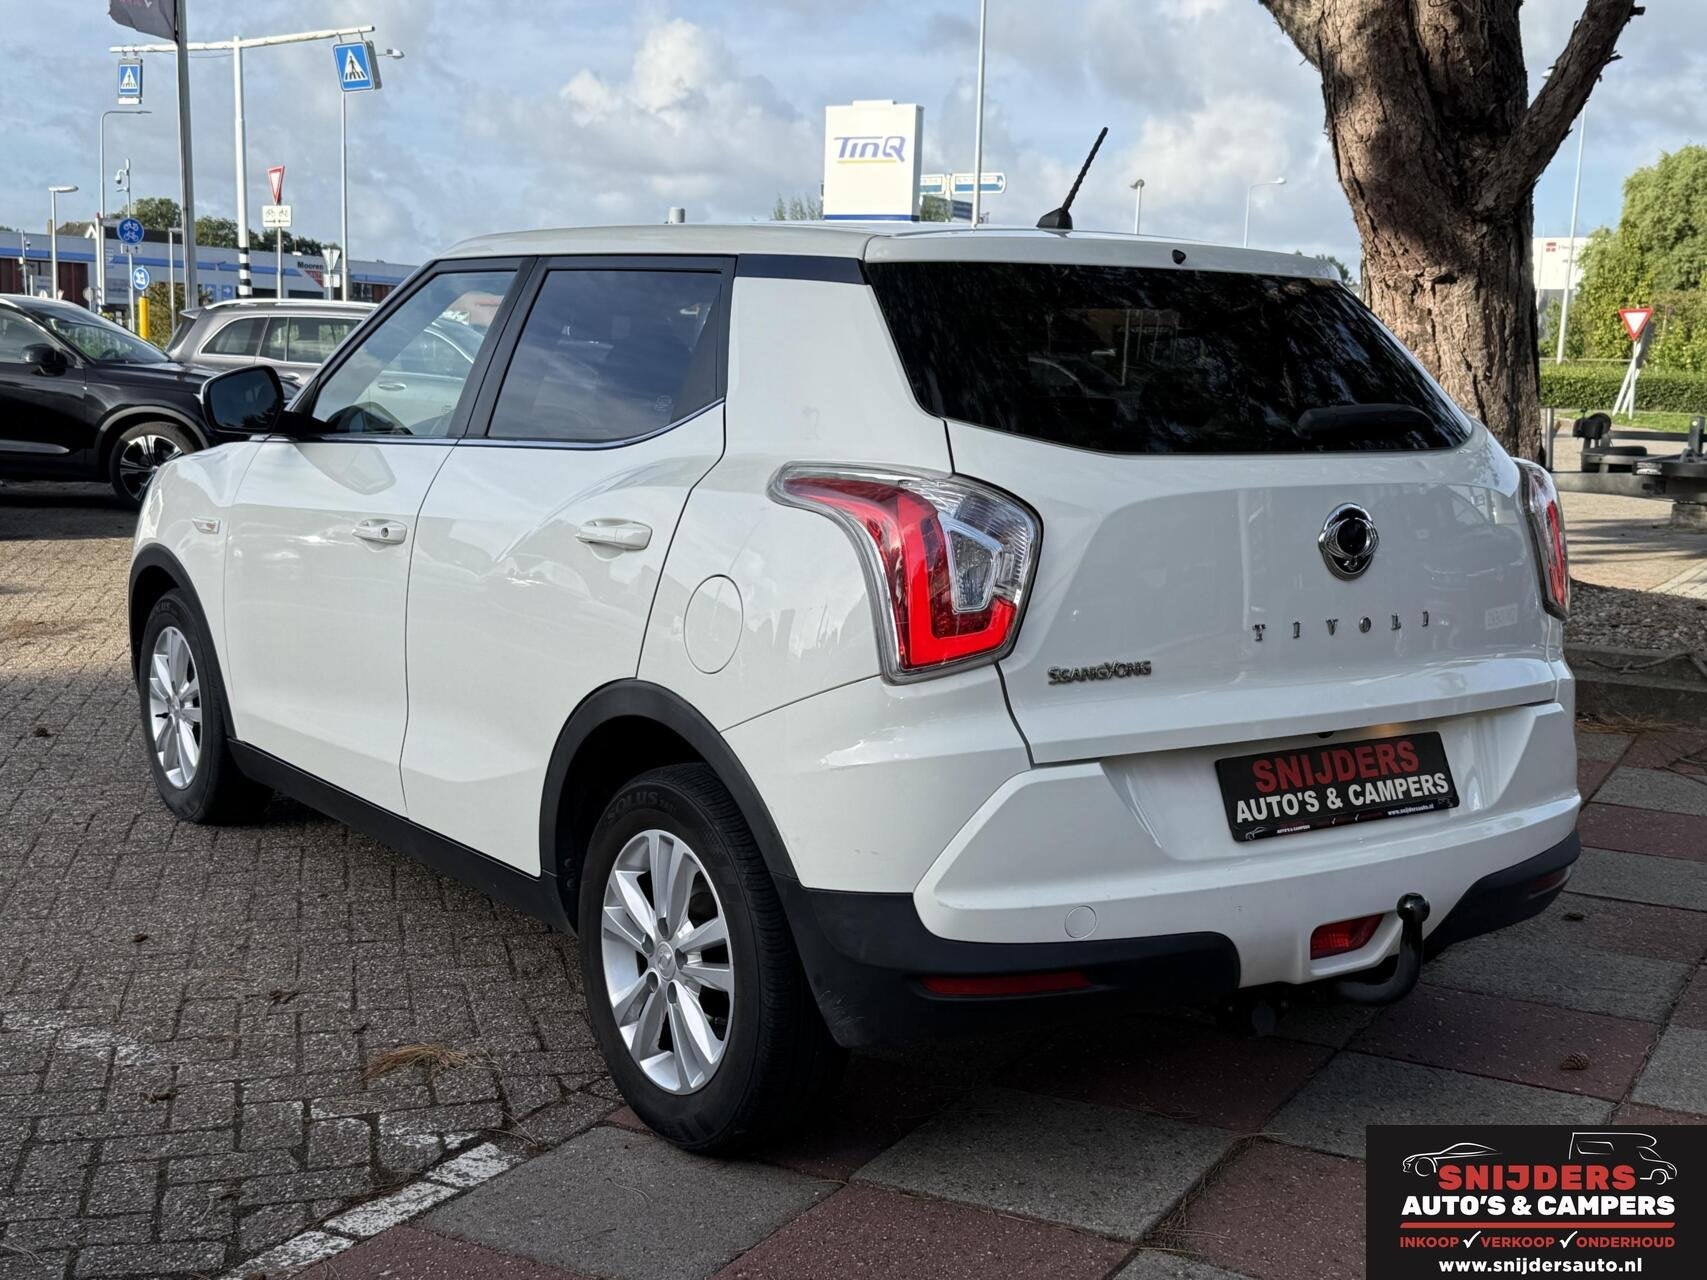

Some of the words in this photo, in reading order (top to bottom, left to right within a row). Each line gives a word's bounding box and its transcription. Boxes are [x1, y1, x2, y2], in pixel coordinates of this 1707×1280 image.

[834, 135, 906, 162] TinQ
[1252, 611, 1430, 642] TIVOLI
[1252, 741, 1420, 794] SNIJDERS
[1236, 792, 1319, 824] AUTO'S
[1326, 787, 1343, 809] &
[1347, 773, 1449, 807] CAMPERS
